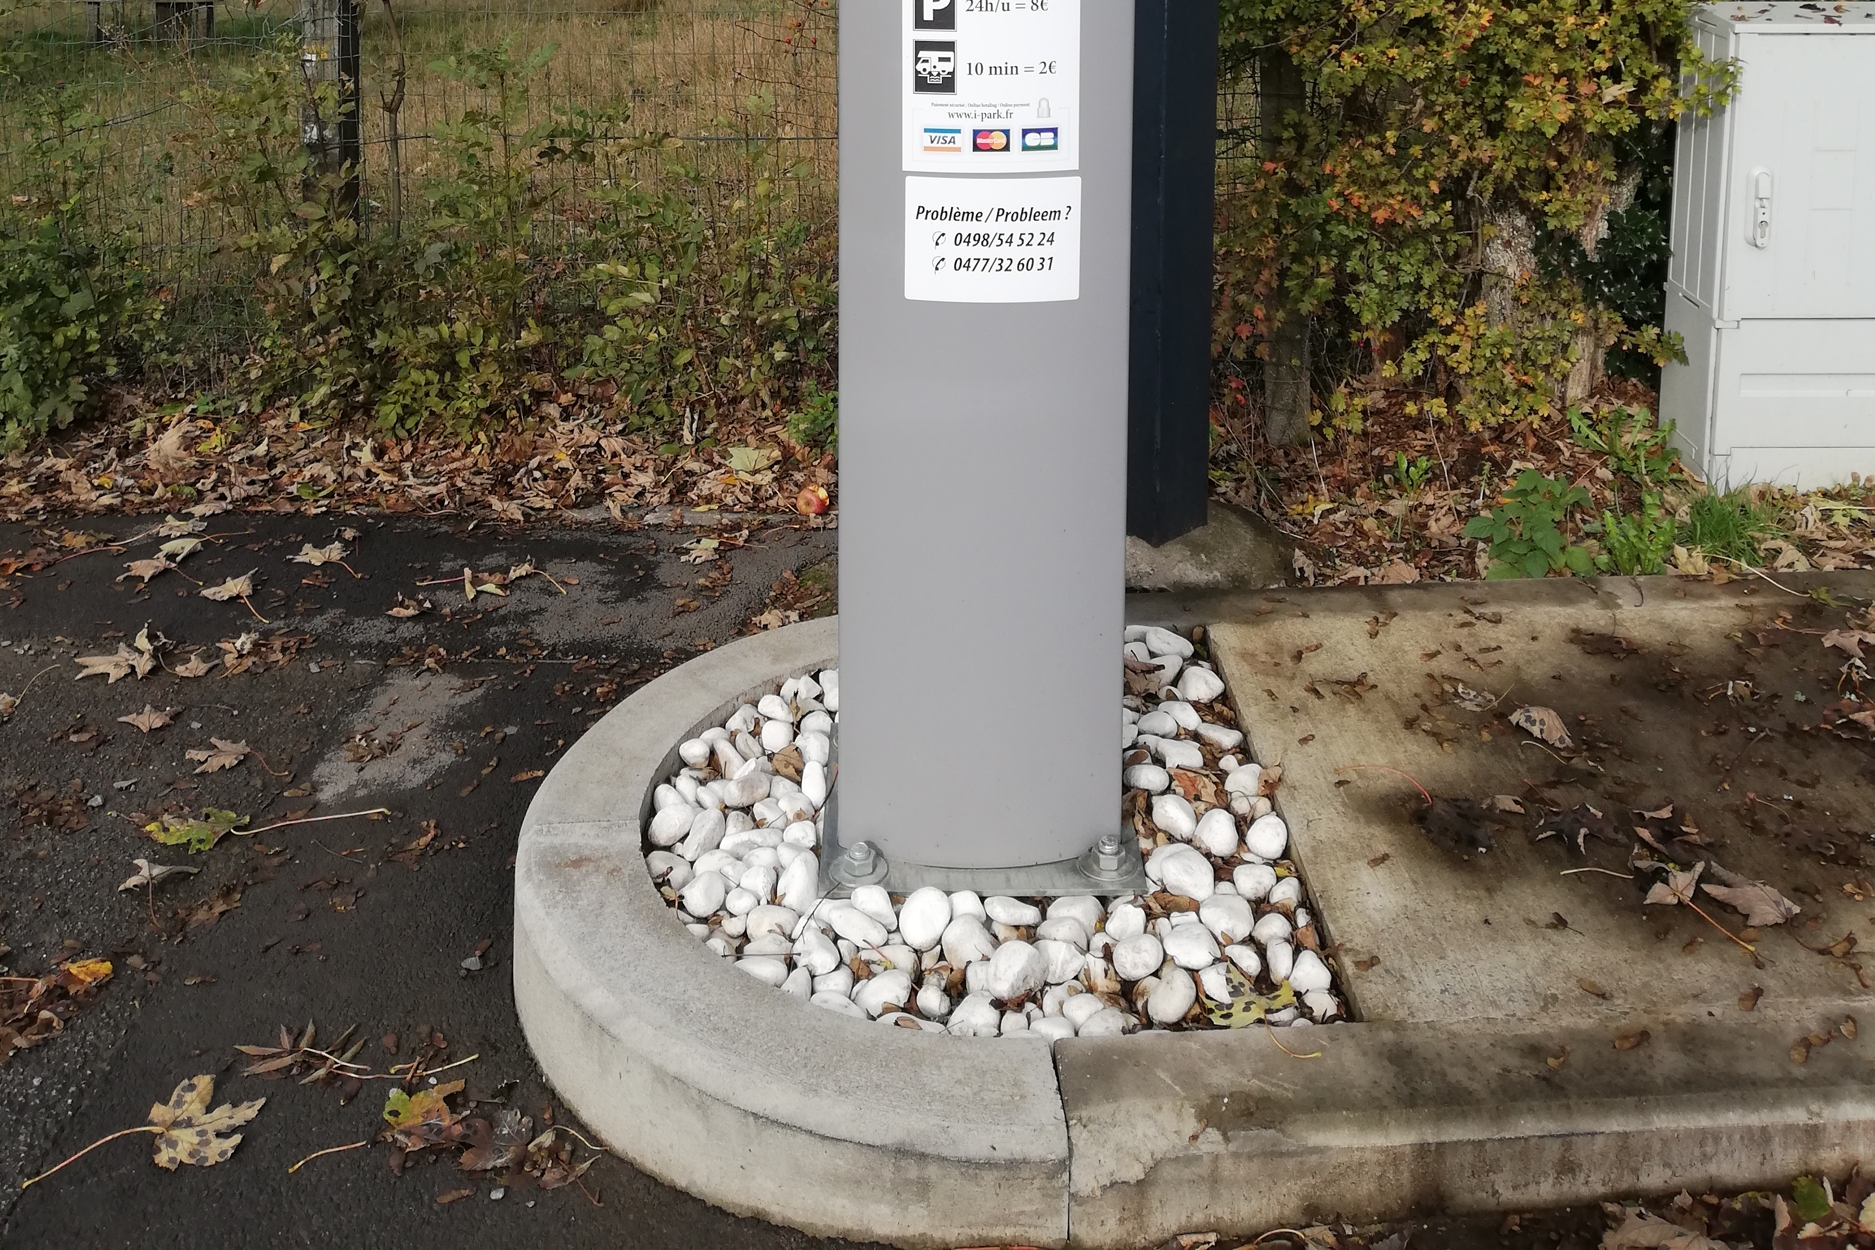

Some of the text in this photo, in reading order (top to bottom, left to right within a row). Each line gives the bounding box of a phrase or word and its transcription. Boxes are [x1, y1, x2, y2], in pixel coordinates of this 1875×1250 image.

[1015, 2, 1026, 10] =
[966, 60, 1057, 76] 10 min = 2€
[947, 109, 1014, 122] www.i-park.fr
[928, 134, 956, 145] VISA
[915, 205, 1072, 223] Problème / Probleem ?
[954, 231, 1055, 248] 0498/54 52 24
[953, 256, 1054, 273] 0477/32 60 31
